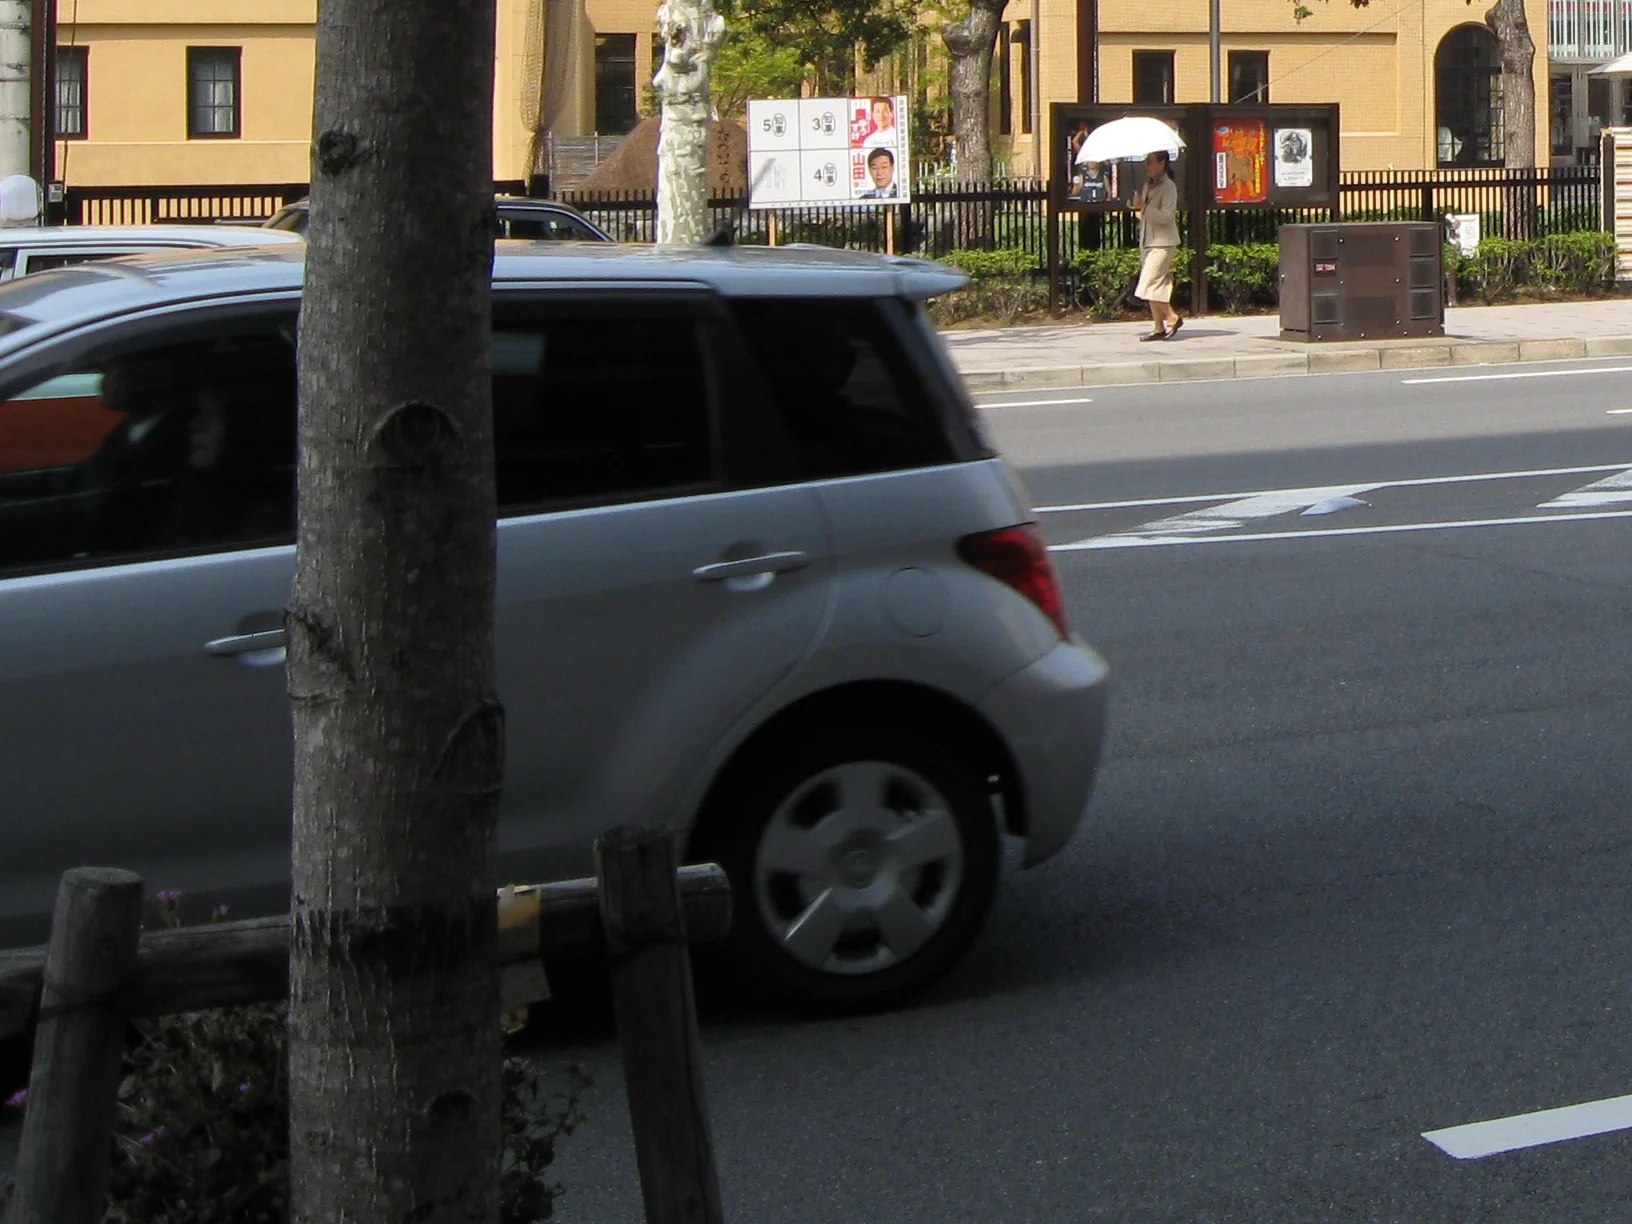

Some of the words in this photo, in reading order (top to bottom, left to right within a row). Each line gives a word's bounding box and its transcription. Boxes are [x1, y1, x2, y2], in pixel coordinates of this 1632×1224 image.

[763, 119, 771, 132] 5
[812, 117, 821, 130] 3
[852, 152, 866, 180] 山田
[813, 168, 822, 181] 4
